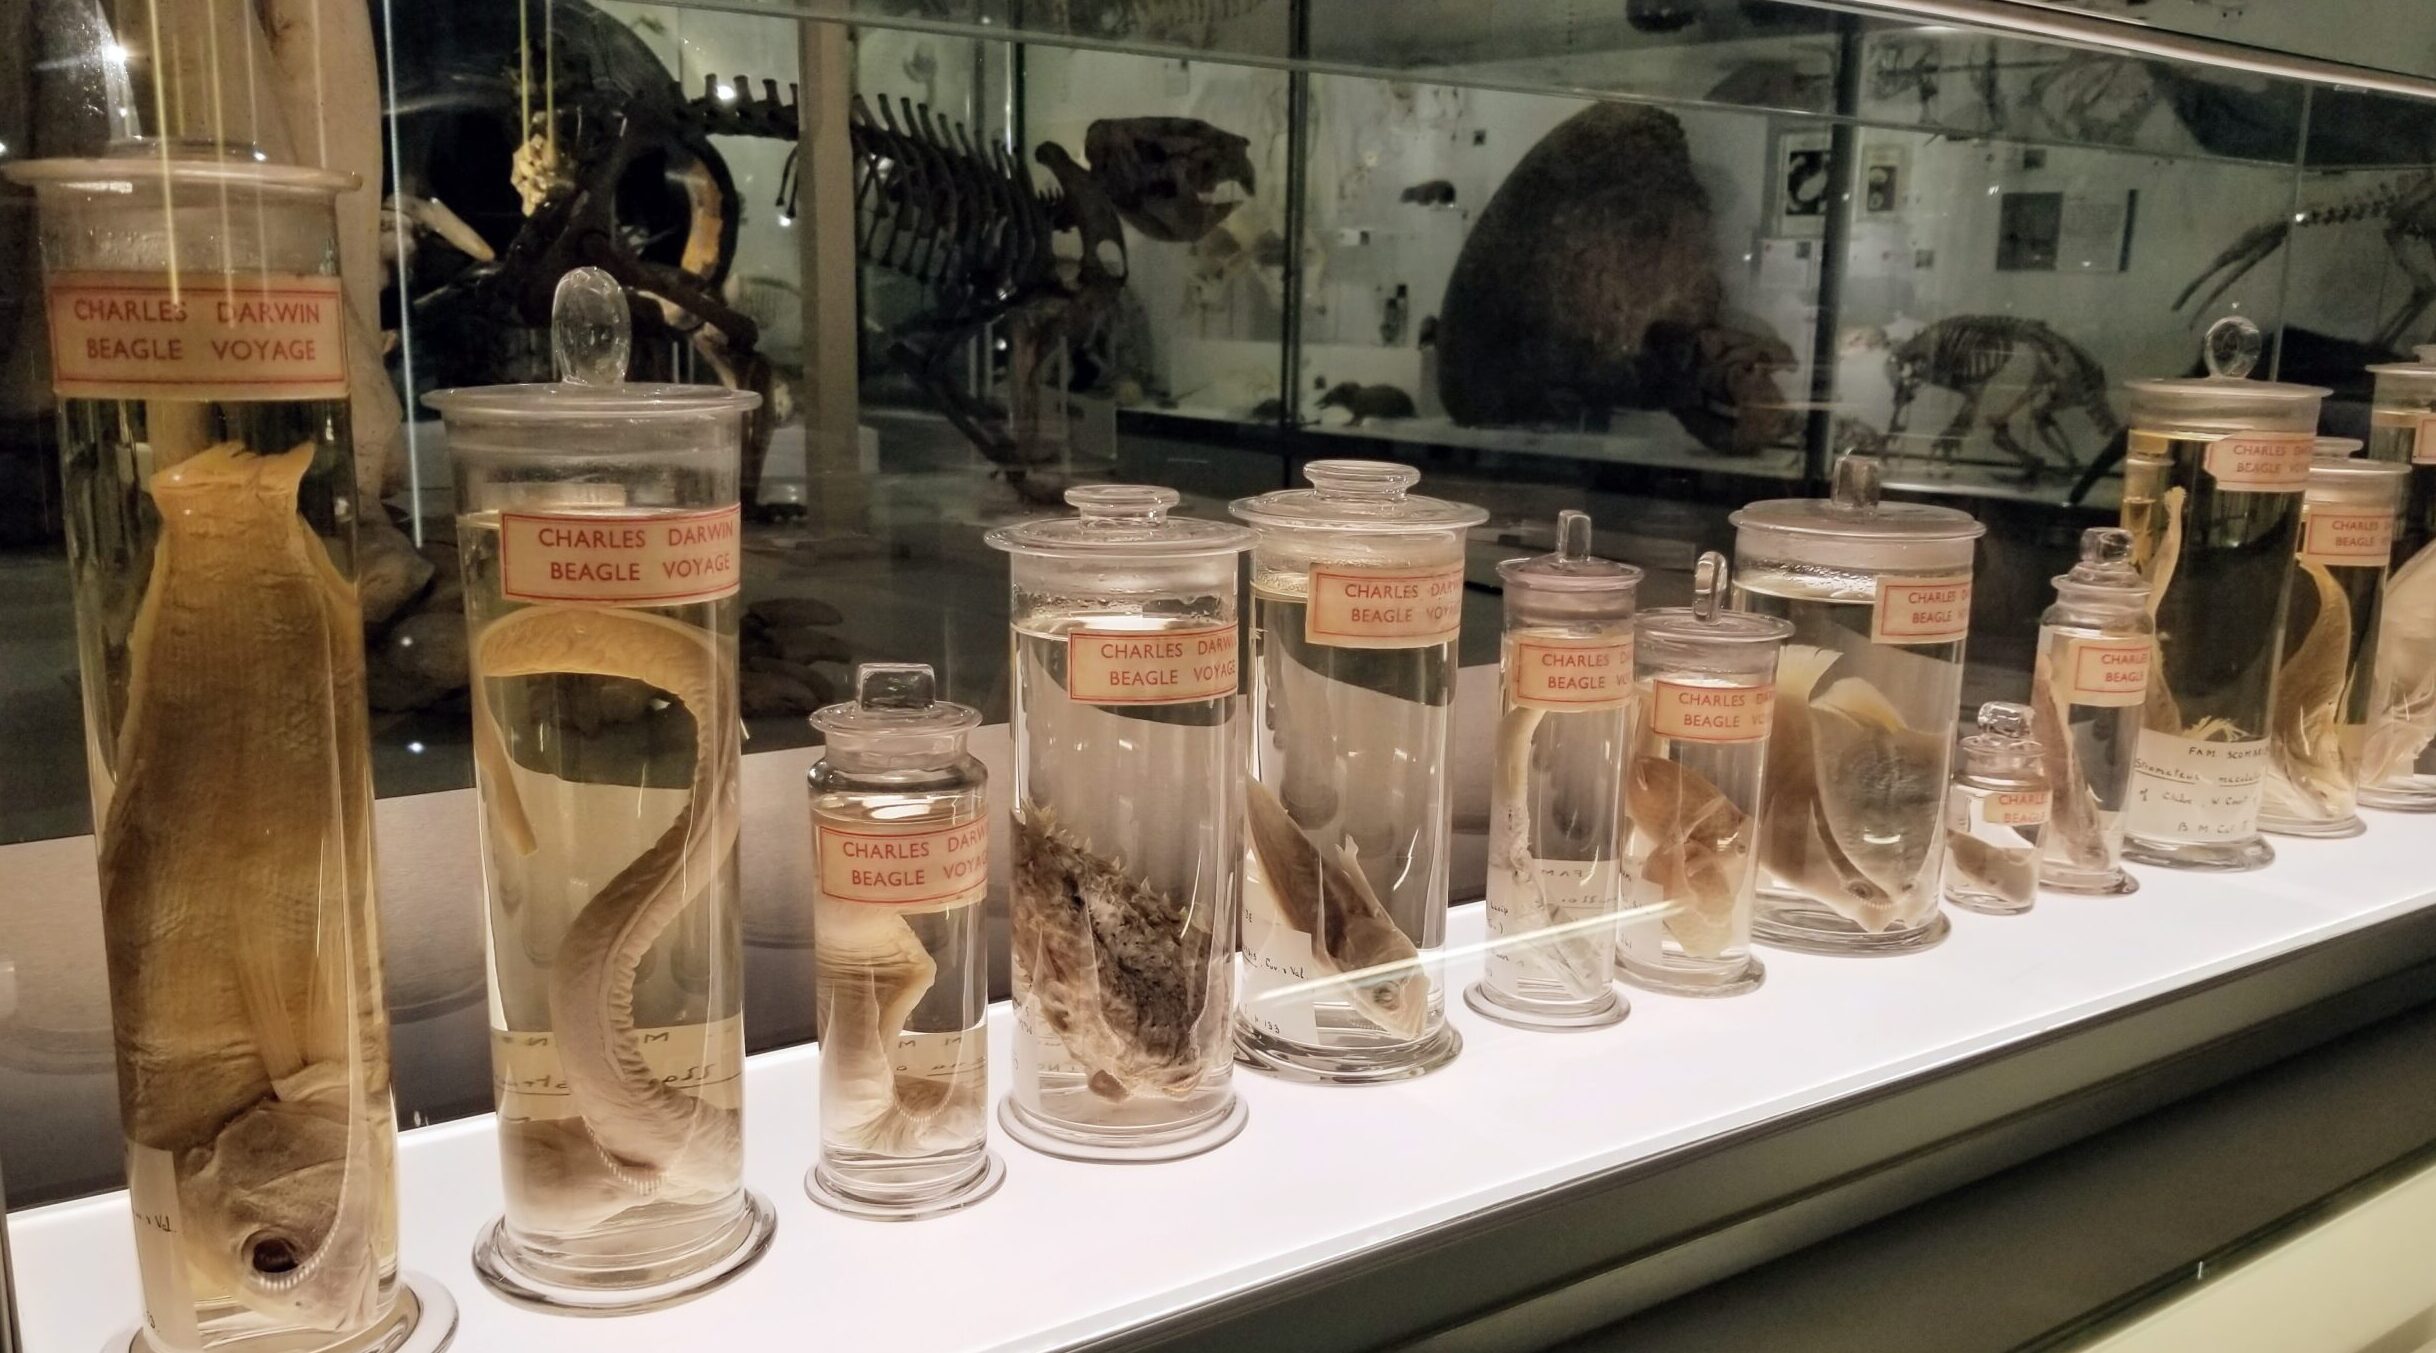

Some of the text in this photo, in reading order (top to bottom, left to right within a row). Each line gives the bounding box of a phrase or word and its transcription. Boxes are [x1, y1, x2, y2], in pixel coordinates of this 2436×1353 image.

[73, 299, 320, 324] CHARLES DARWIN
[86, 338, 317, 362] BEAGLE VOYAGE
[538, 520, 733, 549] CHARLES DARWIN
[550, 553, 731, 581] BEAGLE VOYAGE
[1344, 583, 1419, 599] CHARLES
[1351, 608, 1413, 623] BEAGLE
[1100, 642, 1183, 659] CHARLES
[1541, 653, 1609, 667] CHARLES
[1109, 669, 1178, 686] BEAGLE
[1547, 676, 1605, 690] BEAGLE
[1679, 692, 1745, 707] CHARLES
[1683, 714, 1740, 728] BEAGLE
[842, 826, 986, 859] CHARLES DARW
[851, 869, 926, 886] BEAGLE
